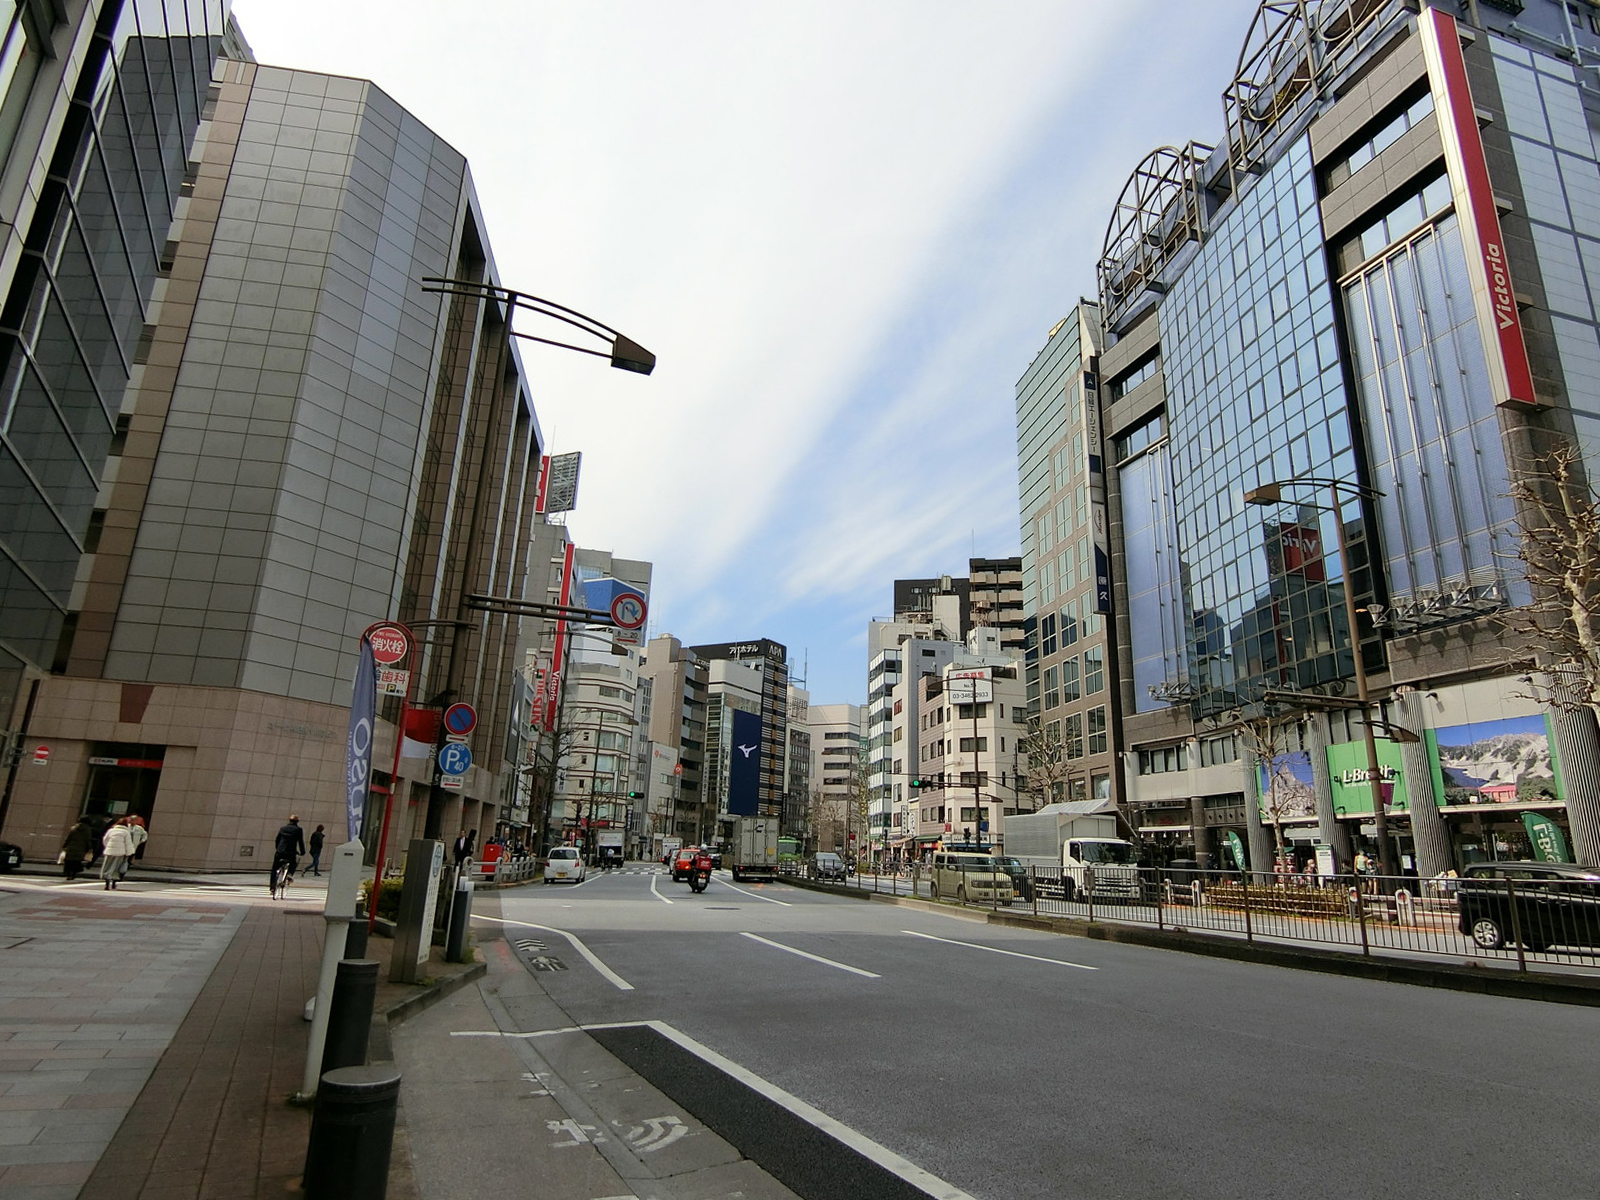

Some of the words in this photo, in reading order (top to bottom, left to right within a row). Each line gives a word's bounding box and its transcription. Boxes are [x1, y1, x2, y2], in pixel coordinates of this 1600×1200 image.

[1486, 242, 1515, 330] Victoria
[372, 636, 404, 655] 消火栓
[549, 671, 560, 701] Victoria
[445, 749, 461, 770] P
[454, 760, 464, 772] 40
